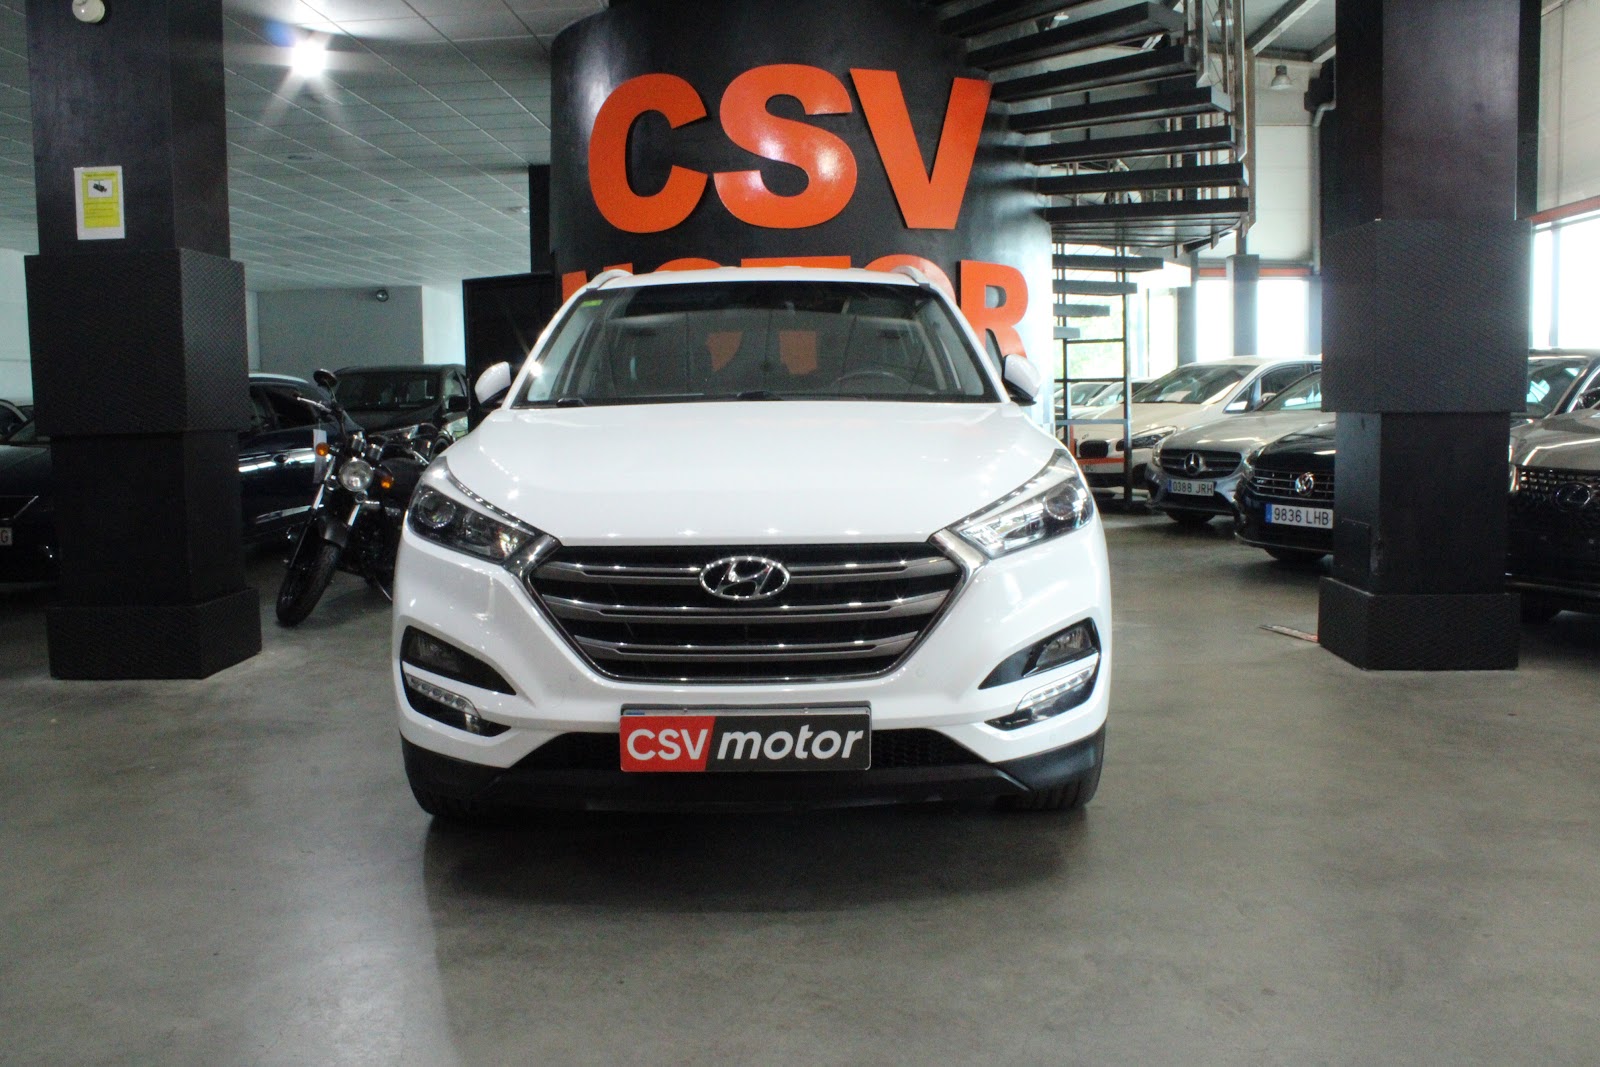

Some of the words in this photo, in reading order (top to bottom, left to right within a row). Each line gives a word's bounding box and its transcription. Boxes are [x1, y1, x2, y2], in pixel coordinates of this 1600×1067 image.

[588, 63, 992, 234] CSV
[1172, 481, 1192, 493] 0388
[1195, 484, 1213, 494] JRH
[1274, 507, 1302, 523] 9836
[1305, 510, 1329, 526] LHB
[626, 728, 708, 761] CSV
[716, 724, 864, 760] motor
